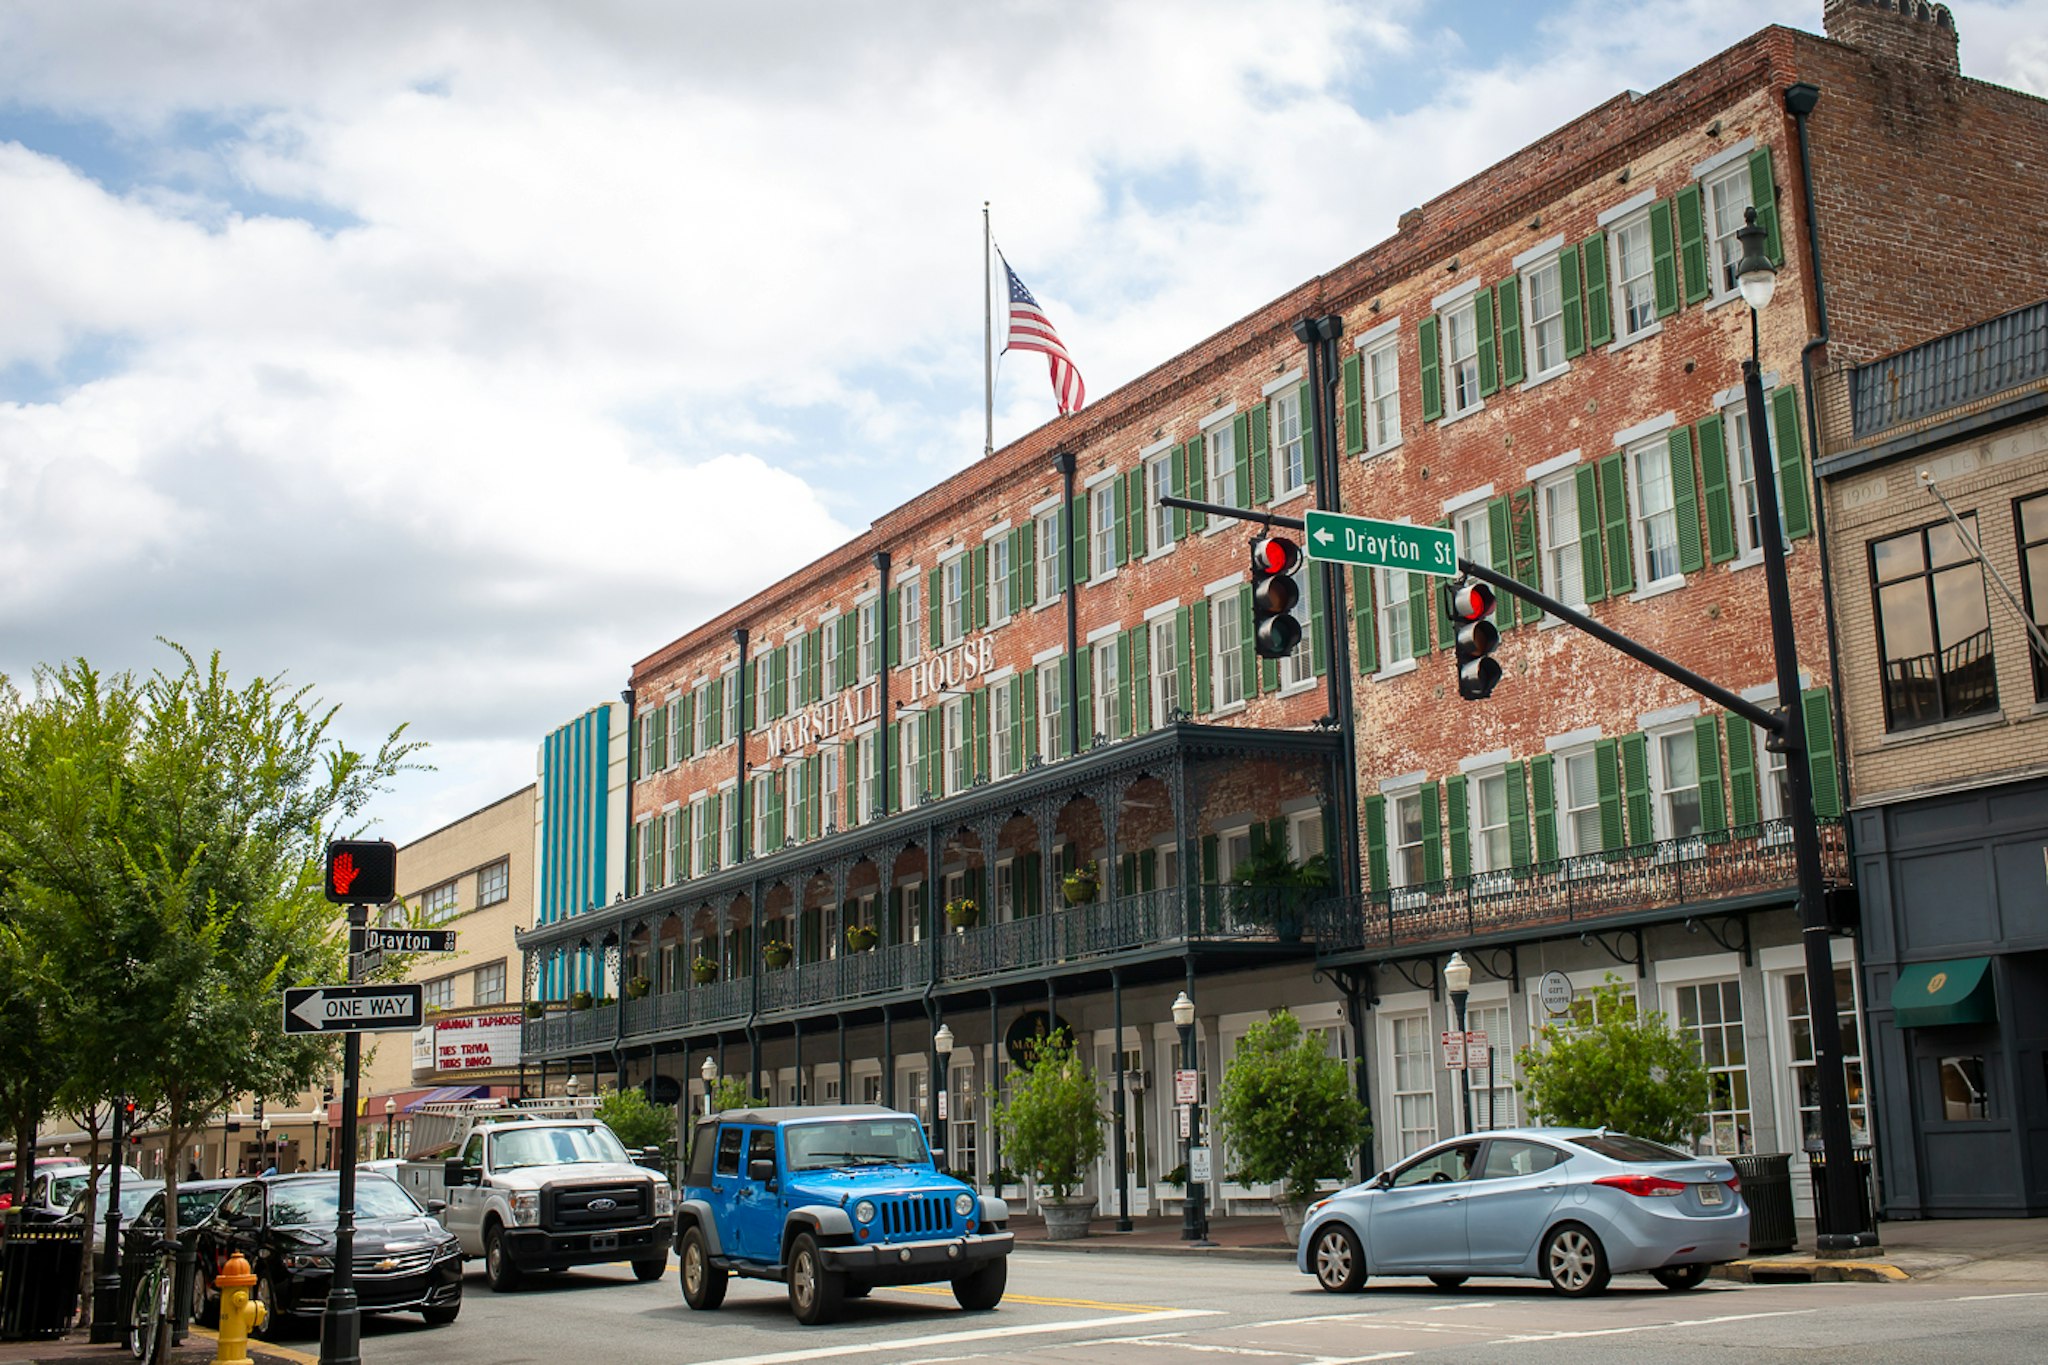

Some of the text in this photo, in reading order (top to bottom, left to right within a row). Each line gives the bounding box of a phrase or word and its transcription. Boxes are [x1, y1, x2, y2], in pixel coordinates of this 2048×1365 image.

[1345, 527, 1452, 566] Drayton St
[910, 634, 996, 701] HOUSE
[766, 682, 880, 760] MARSHALL
[370, 931, 430, 950] Drayton
[326, 998, 408, 1018] ONE WAY
[477, 1015, 521, 1027] TAPHOUS
[439, 1046, 456, 1056] TUES
[461, 1043, 489, 1055] TRIVIA
[465, 1056, 492, 1067] BINGO
